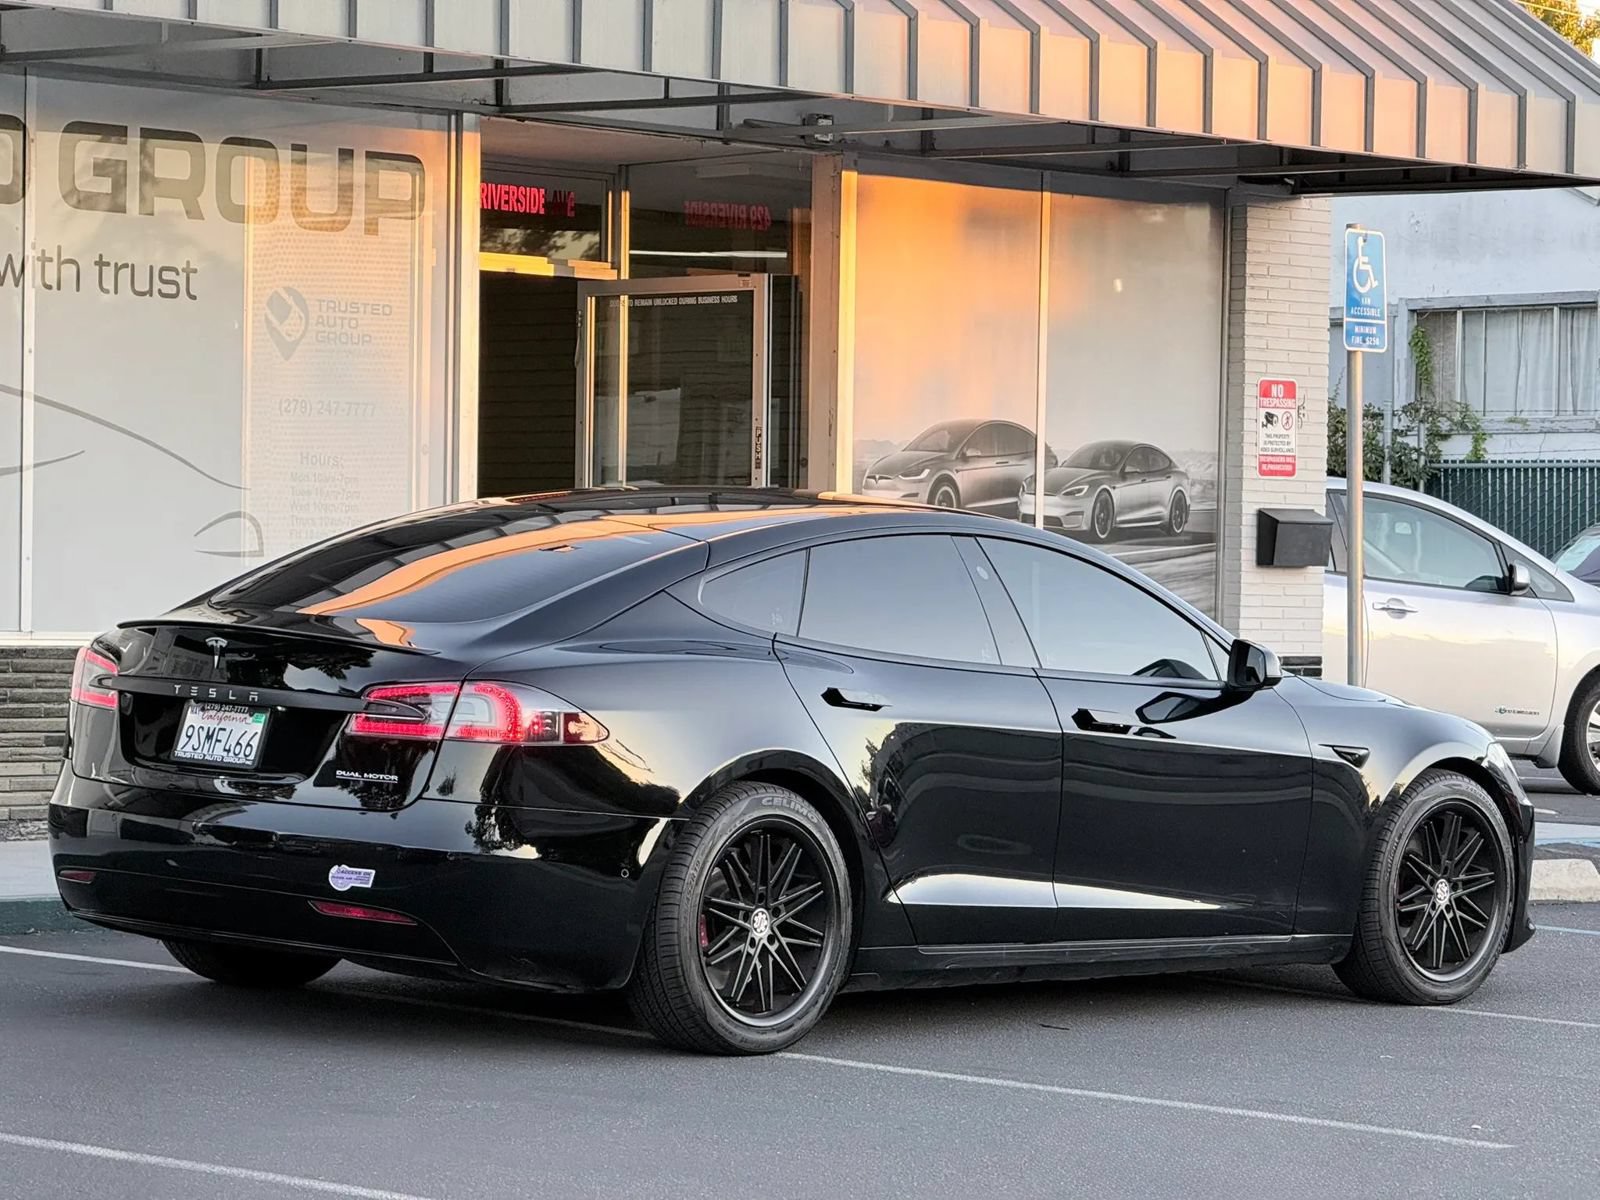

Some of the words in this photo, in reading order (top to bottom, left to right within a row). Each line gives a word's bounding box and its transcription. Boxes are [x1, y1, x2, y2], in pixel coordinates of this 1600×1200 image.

[58, 120, 426, 236] GROUP
[480, 182, 546, 214] RIVERSIDE
[93, 253, 198, 301] trust
[315, 299, 393, 317] TRUSTED
[653, 297, 678, 306] UNLOCKED
[678, 296, 697, 305] DURING
[697, 295, 720, 304] BUSINESS
[721, 294, 738, 304] HOURS
[1350, 306, 1381, 317] ACCESSIBLE
[314, 314, 360, 330] AUTO
[315, 330, 373, 346] GROUP
[1271, 383, 1285, 398] NO
[278, 397, 313, 417] (279)
[316, 399, 377, 417] 247-7777
[1259, 398, 1296, 409] TRESPASSING
[174, 684, 259, 702] TESLA
[204, 703, 220, 711] (279)
[221, 704, 249, 713] 247-7777
[201, 710, 252, 726] California
[181, 724, 259, 758] 9SMF466
[174, 750, 204, 760] TRUSTED
[204, 752, 222, 762] AUTO
[222, 754, 246, 764] GROUP
[335, 769, 362, 778] DUAL
[363, 772, 399, 781] MOTOR
[761, 796, 818, 824] CELIMO
